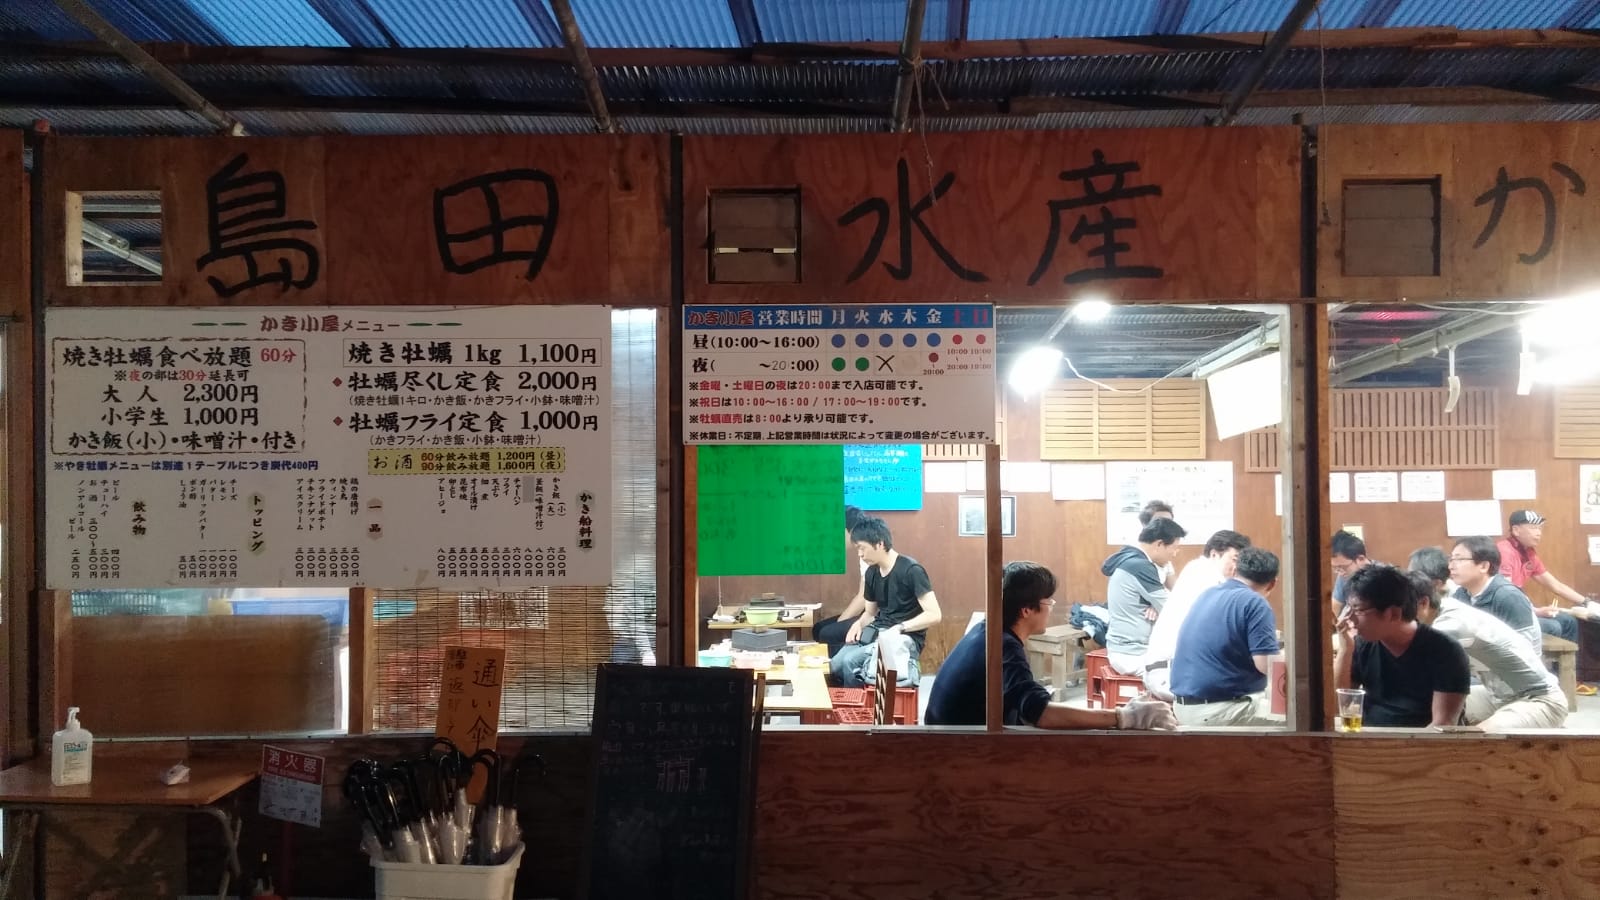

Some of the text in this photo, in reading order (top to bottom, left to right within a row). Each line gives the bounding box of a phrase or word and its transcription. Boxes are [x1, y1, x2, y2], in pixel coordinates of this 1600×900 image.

[1472, 161, 1586, 266] か
[261, 315, 400, 332] かき小屋メニュー
[832, 310, 846, 324] 月
[854, 310, 869, 324] 火
[878, 310, 893, 324] 水
[902, 309, 917, 324] 木
[926, 308, 942, 324] 金
[63, 346, 296, 370] 焼き牡蠣食べ放題 60分
[349, 341, 596, 367] 焼き牡蠣 1kg 1,100円
[115, 369, 249, 382] ※夜の部は30分延長可
[348, 371, 596, 392] 牡蠣尽くし定食 2,000円
[184, 381, 258, 404] 2,300円
[101, 406, 258, 426] 小学生 1,000円
[349, 411, 598, 433] 牡蠣フライ定食 1,000円
[268, 750, 316, 773] 消火器
